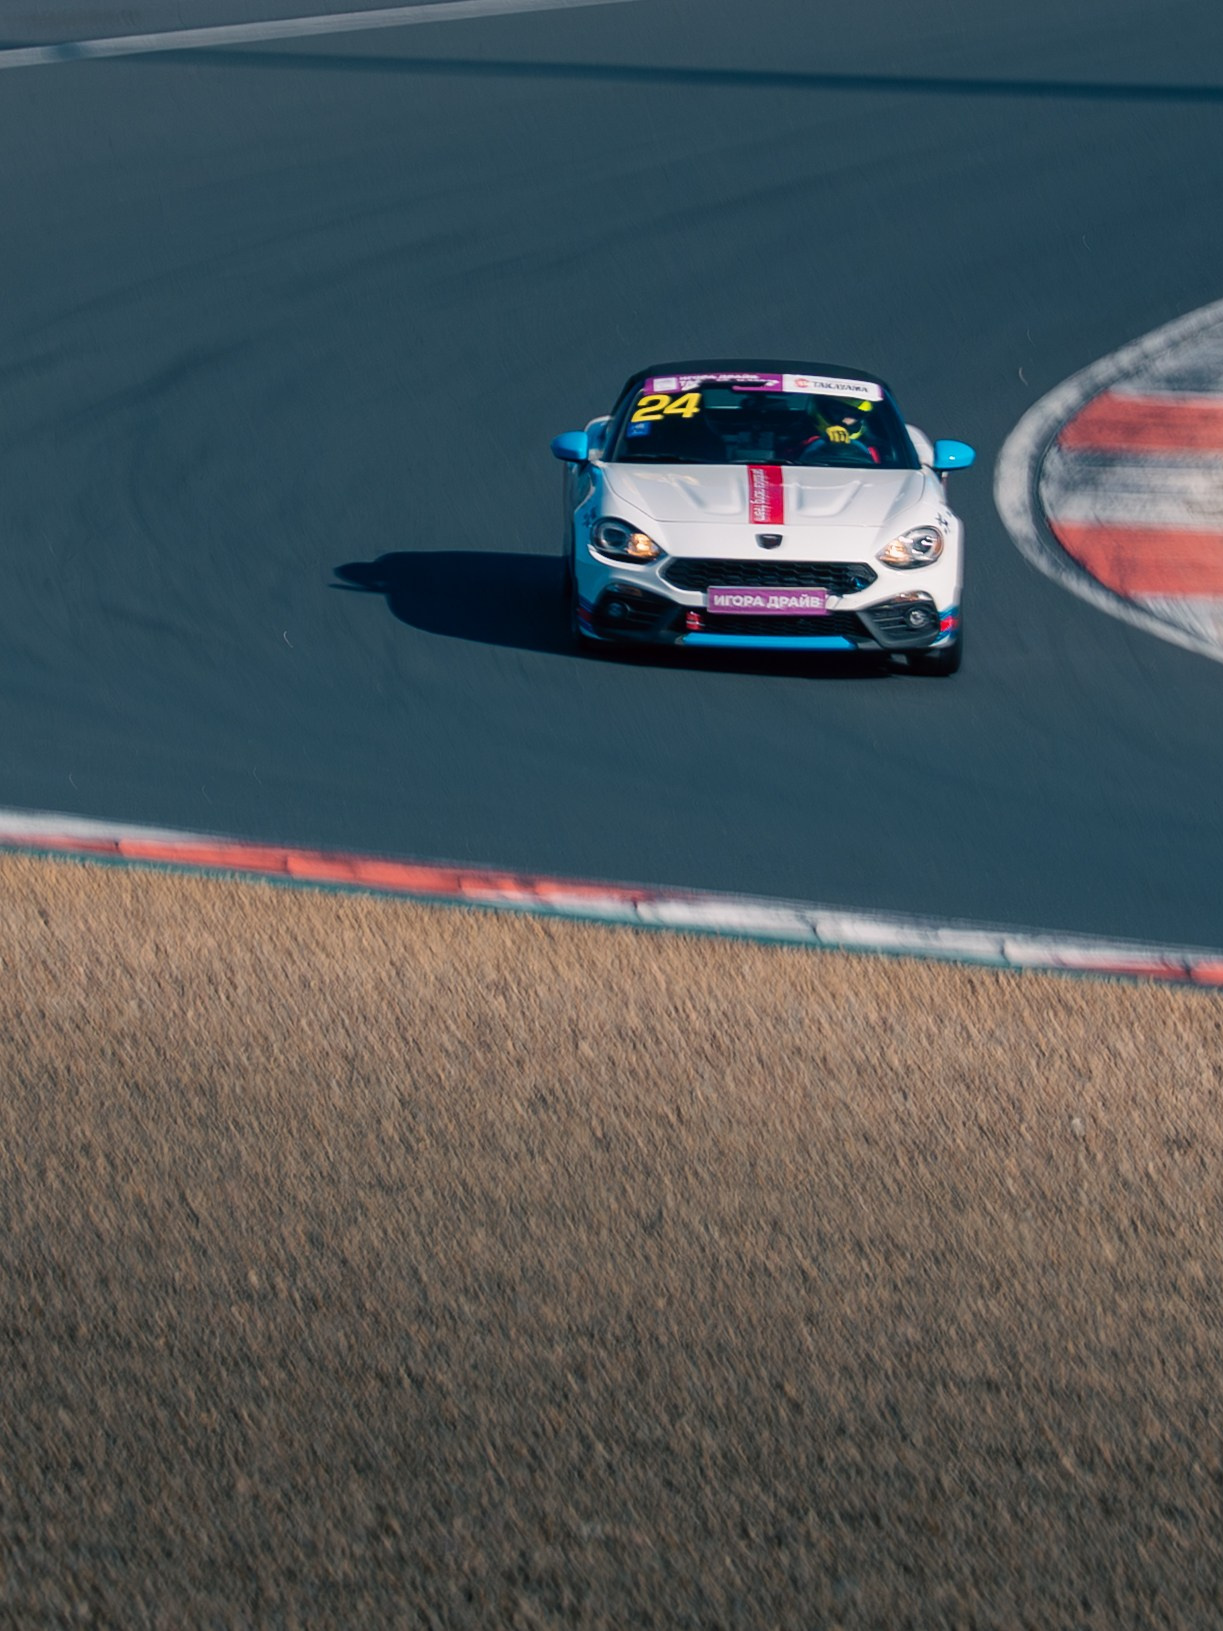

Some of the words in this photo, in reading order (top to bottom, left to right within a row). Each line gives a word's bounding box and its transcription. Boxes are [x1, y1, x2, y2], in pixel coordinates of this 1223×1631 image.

[812, 380, 869, 393] TAKAYAMA
[630, 393, 701, 422] 24
[713, 594, 765, 607] ИГОРА
[766, 593, 822, 609] ДРАЙВ
